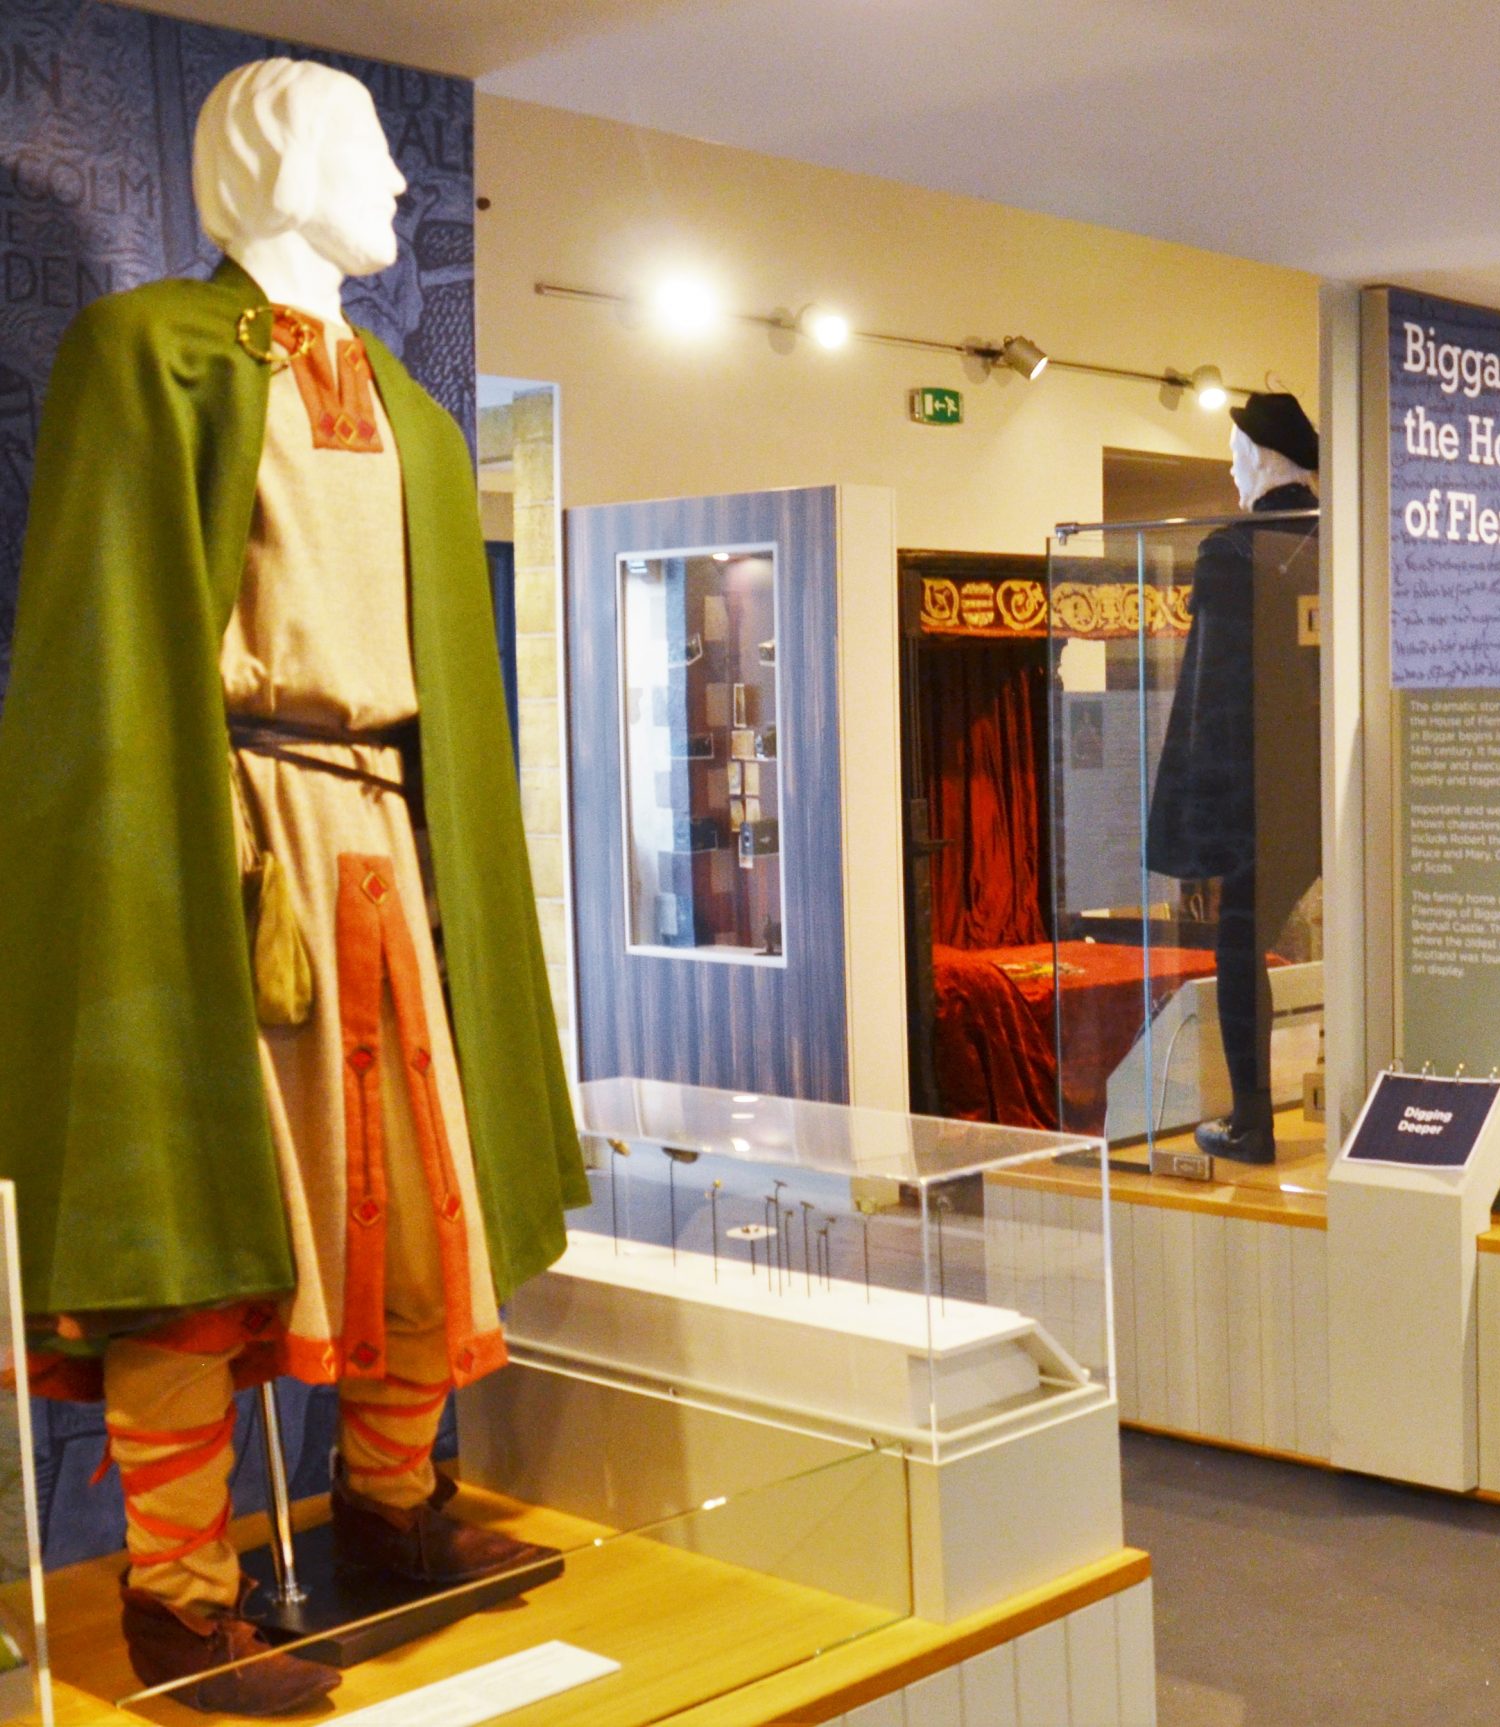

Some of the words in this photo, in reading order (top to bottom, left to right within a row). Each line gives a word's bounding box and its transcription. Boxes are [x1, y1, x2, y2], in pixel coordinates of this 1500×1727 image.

[1404, 406, 1459, 459] the
[1405, 490, 1440, 540] of
[1397, 1119, 1443, 1135] Deeper
[1404, 1106, 1453, 1122] Digging
